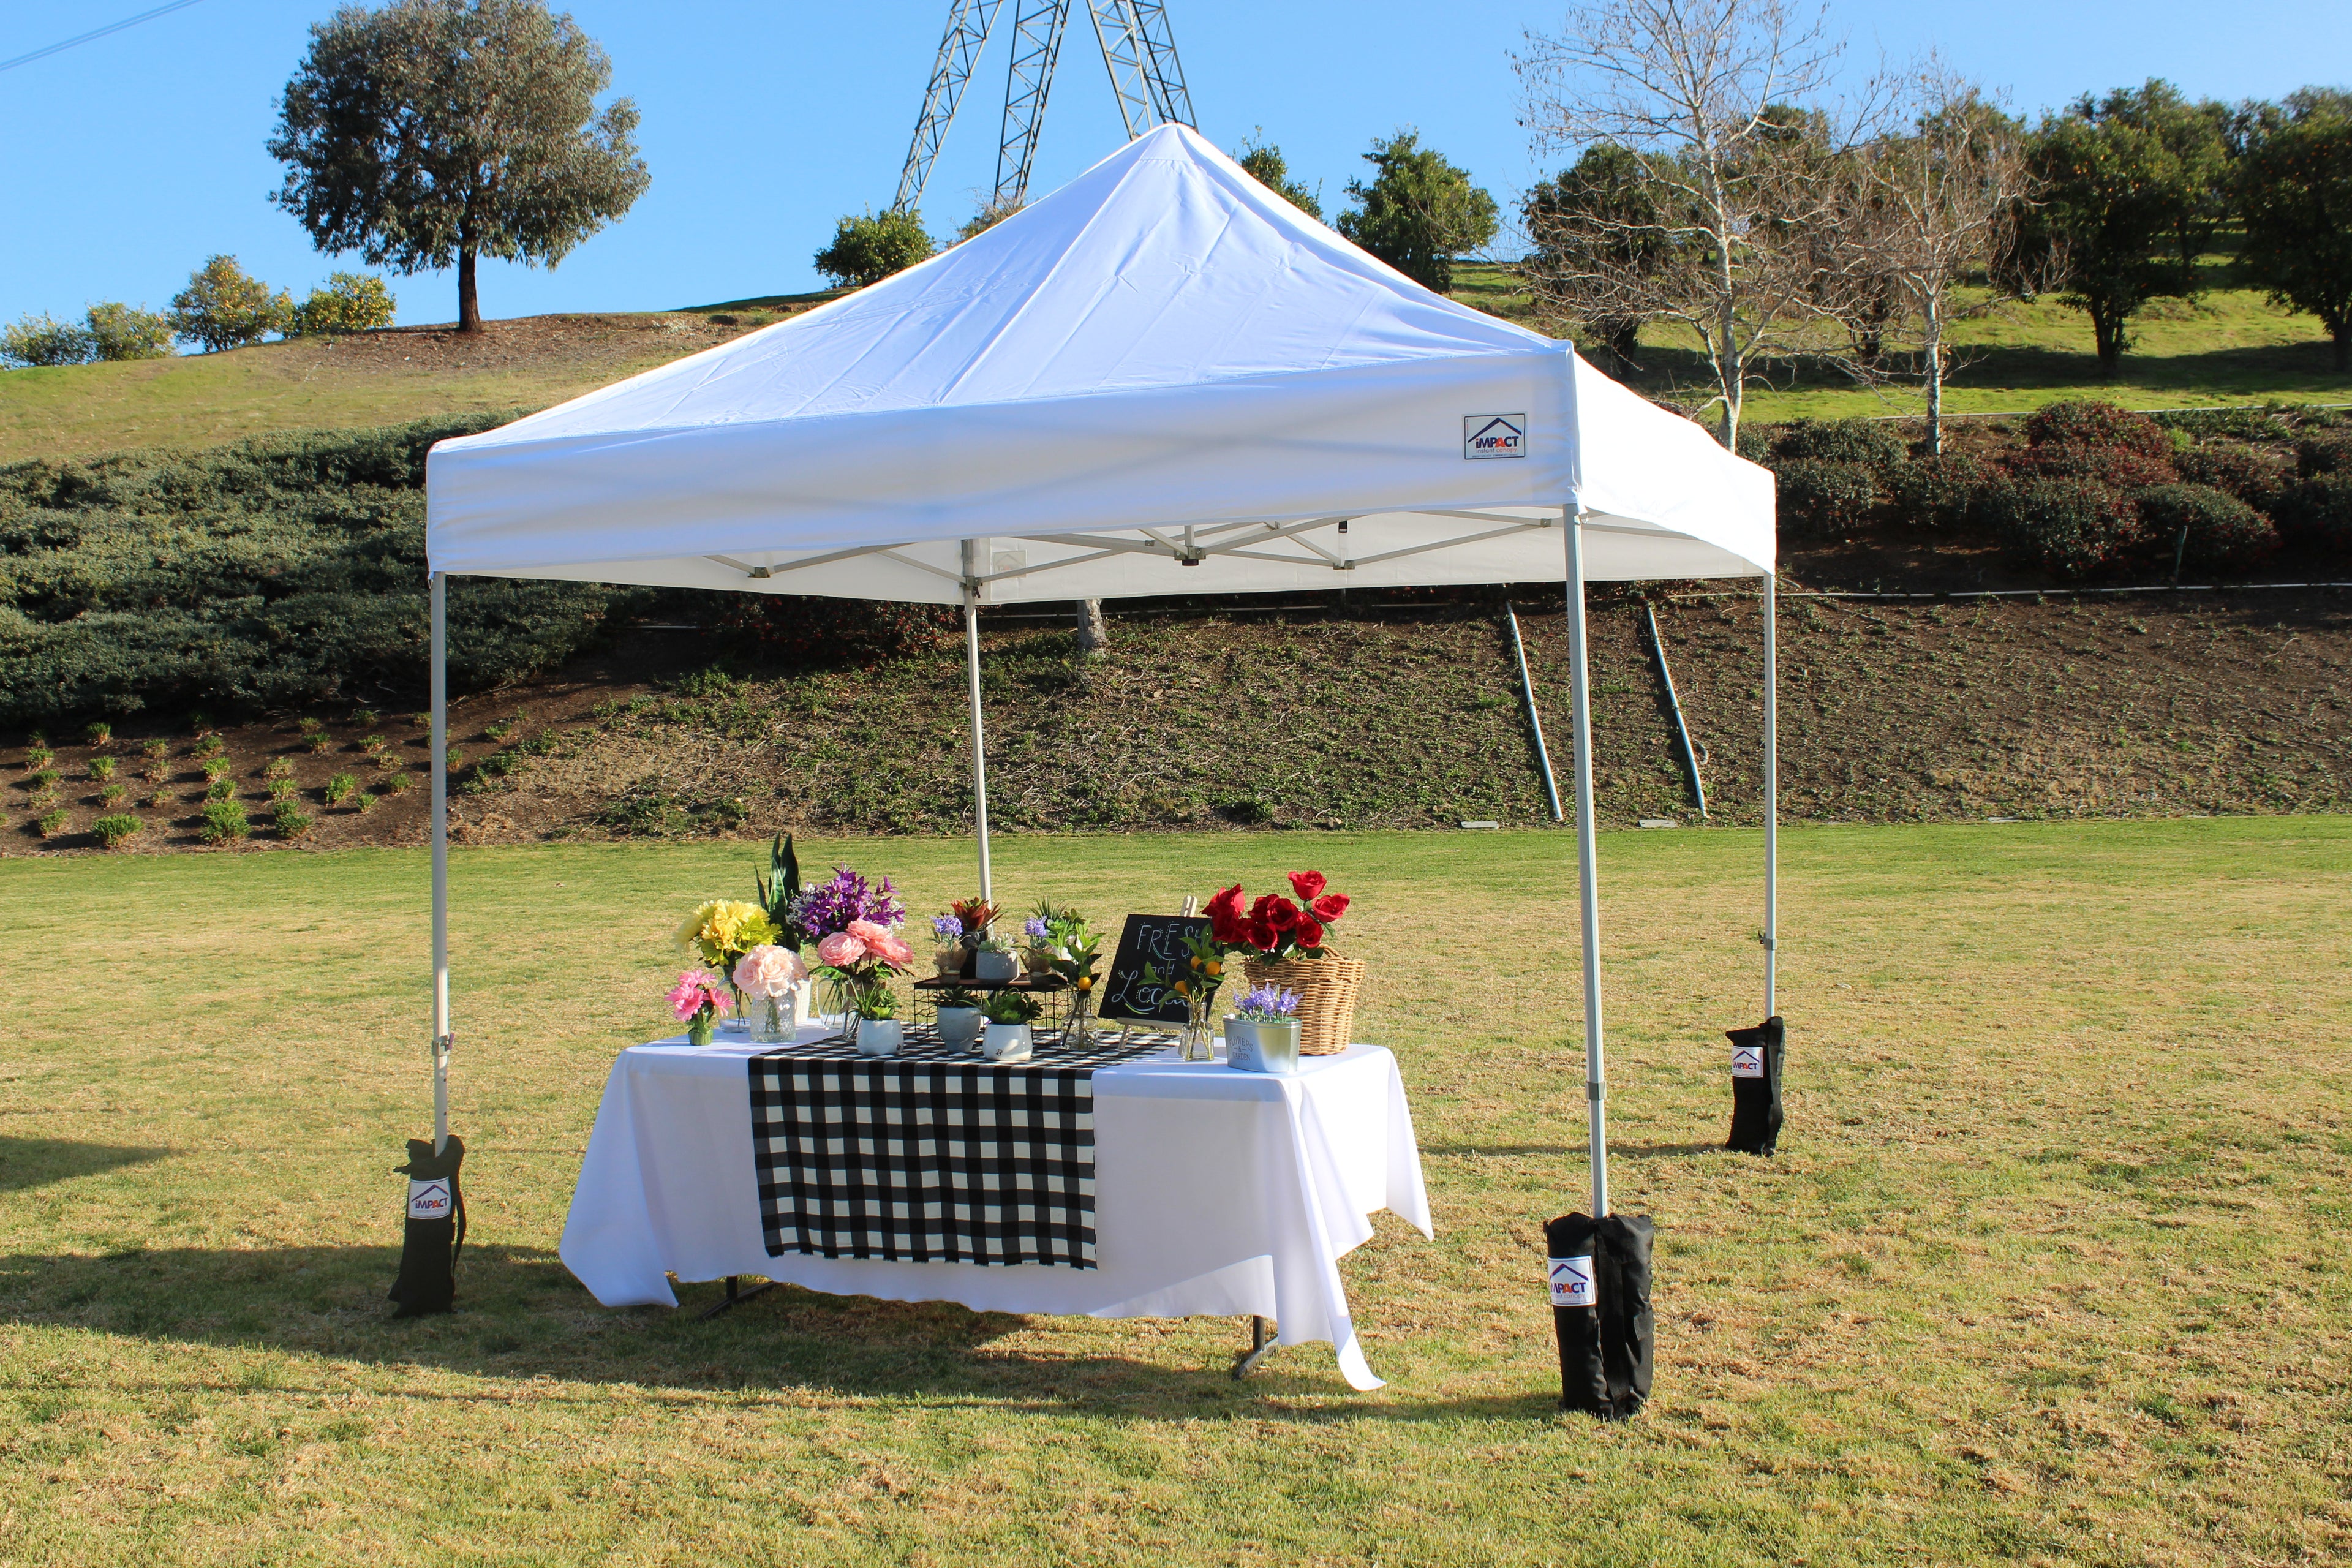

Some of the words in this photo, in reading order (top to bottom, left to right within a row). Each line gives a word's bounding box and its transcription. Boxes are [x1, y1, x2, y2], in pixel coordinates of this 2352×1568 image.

[1111, 970, 1189, 1012] Loc
[1229, 1035, 1254, 1052] FLOWERS
[1232, 1051, 1251, 1061] GARDEN
[1550, 1281, 1586, 1294] MPACT
